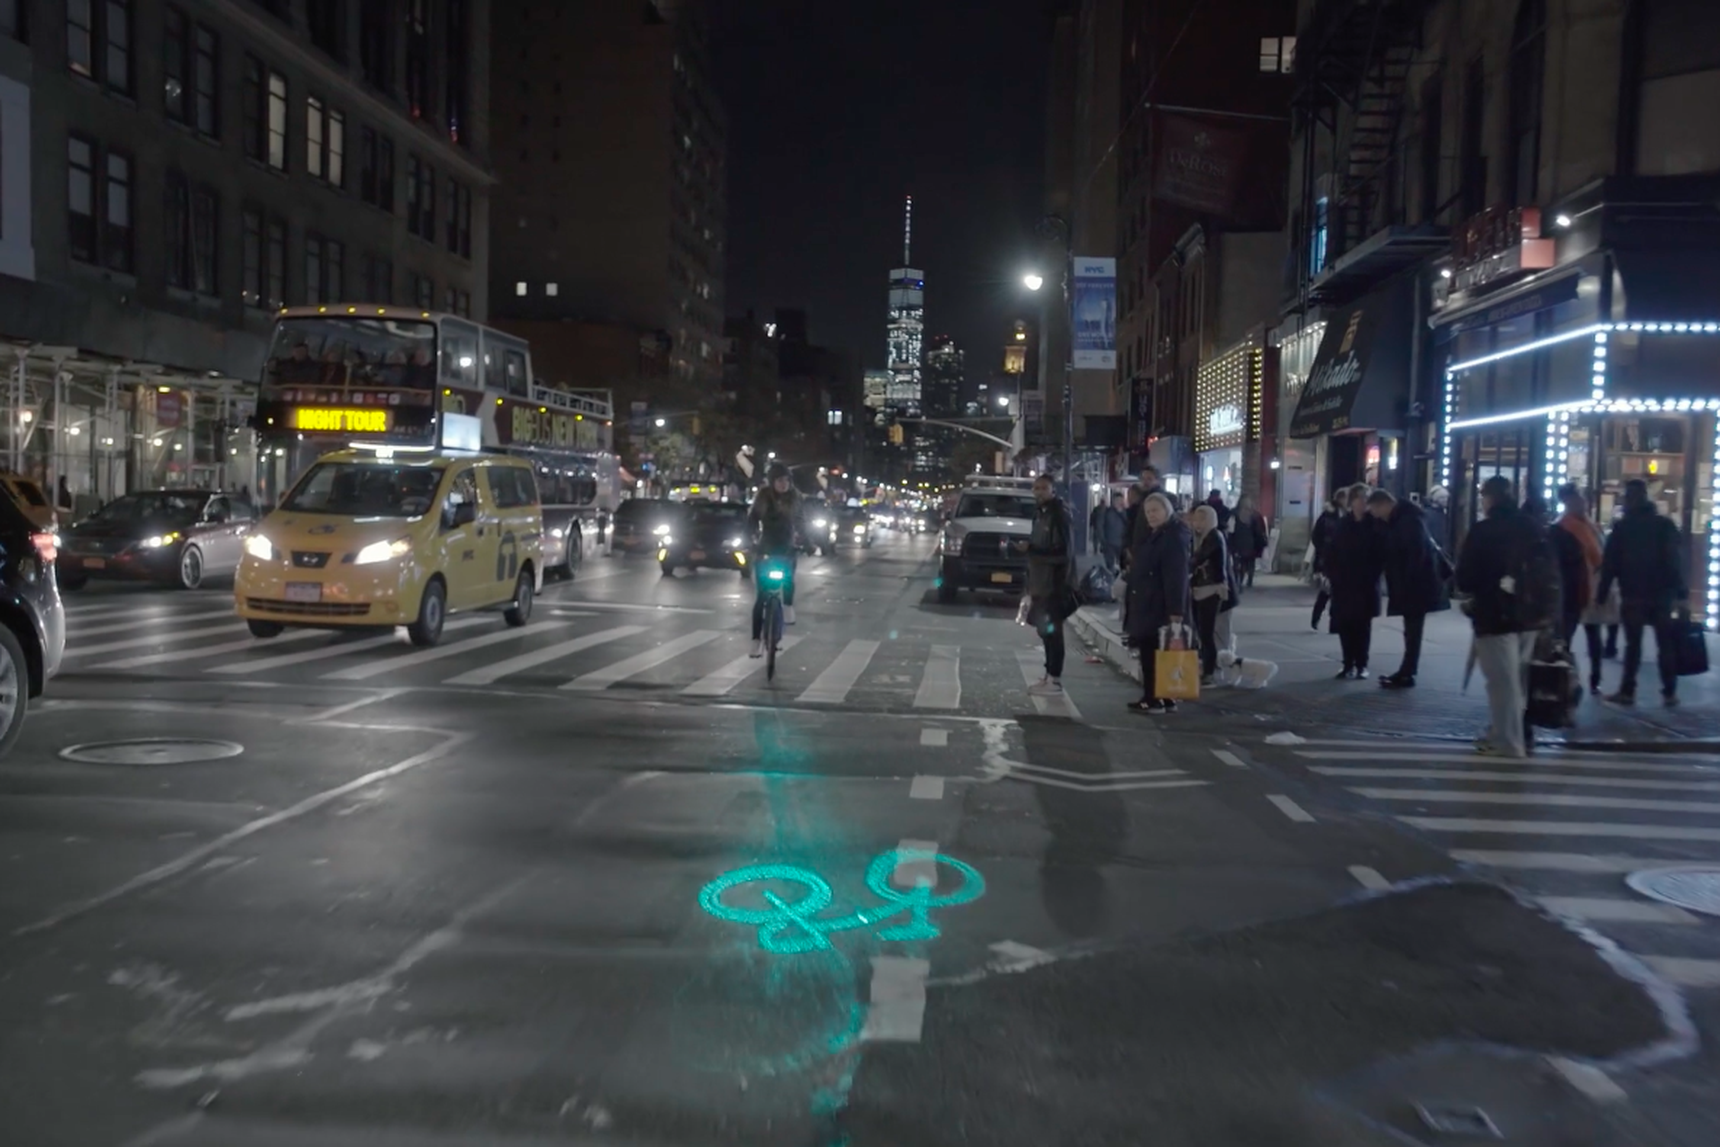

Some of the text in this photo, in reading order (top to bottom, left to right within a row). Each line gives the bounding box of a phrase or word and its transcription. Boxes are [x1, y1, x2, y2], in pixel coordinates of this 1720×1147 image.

[1084, 266, 1105, 274] NYC
[298, 409, 344, 431] NIGHT
[344, 411, 387, 432] TOUR
